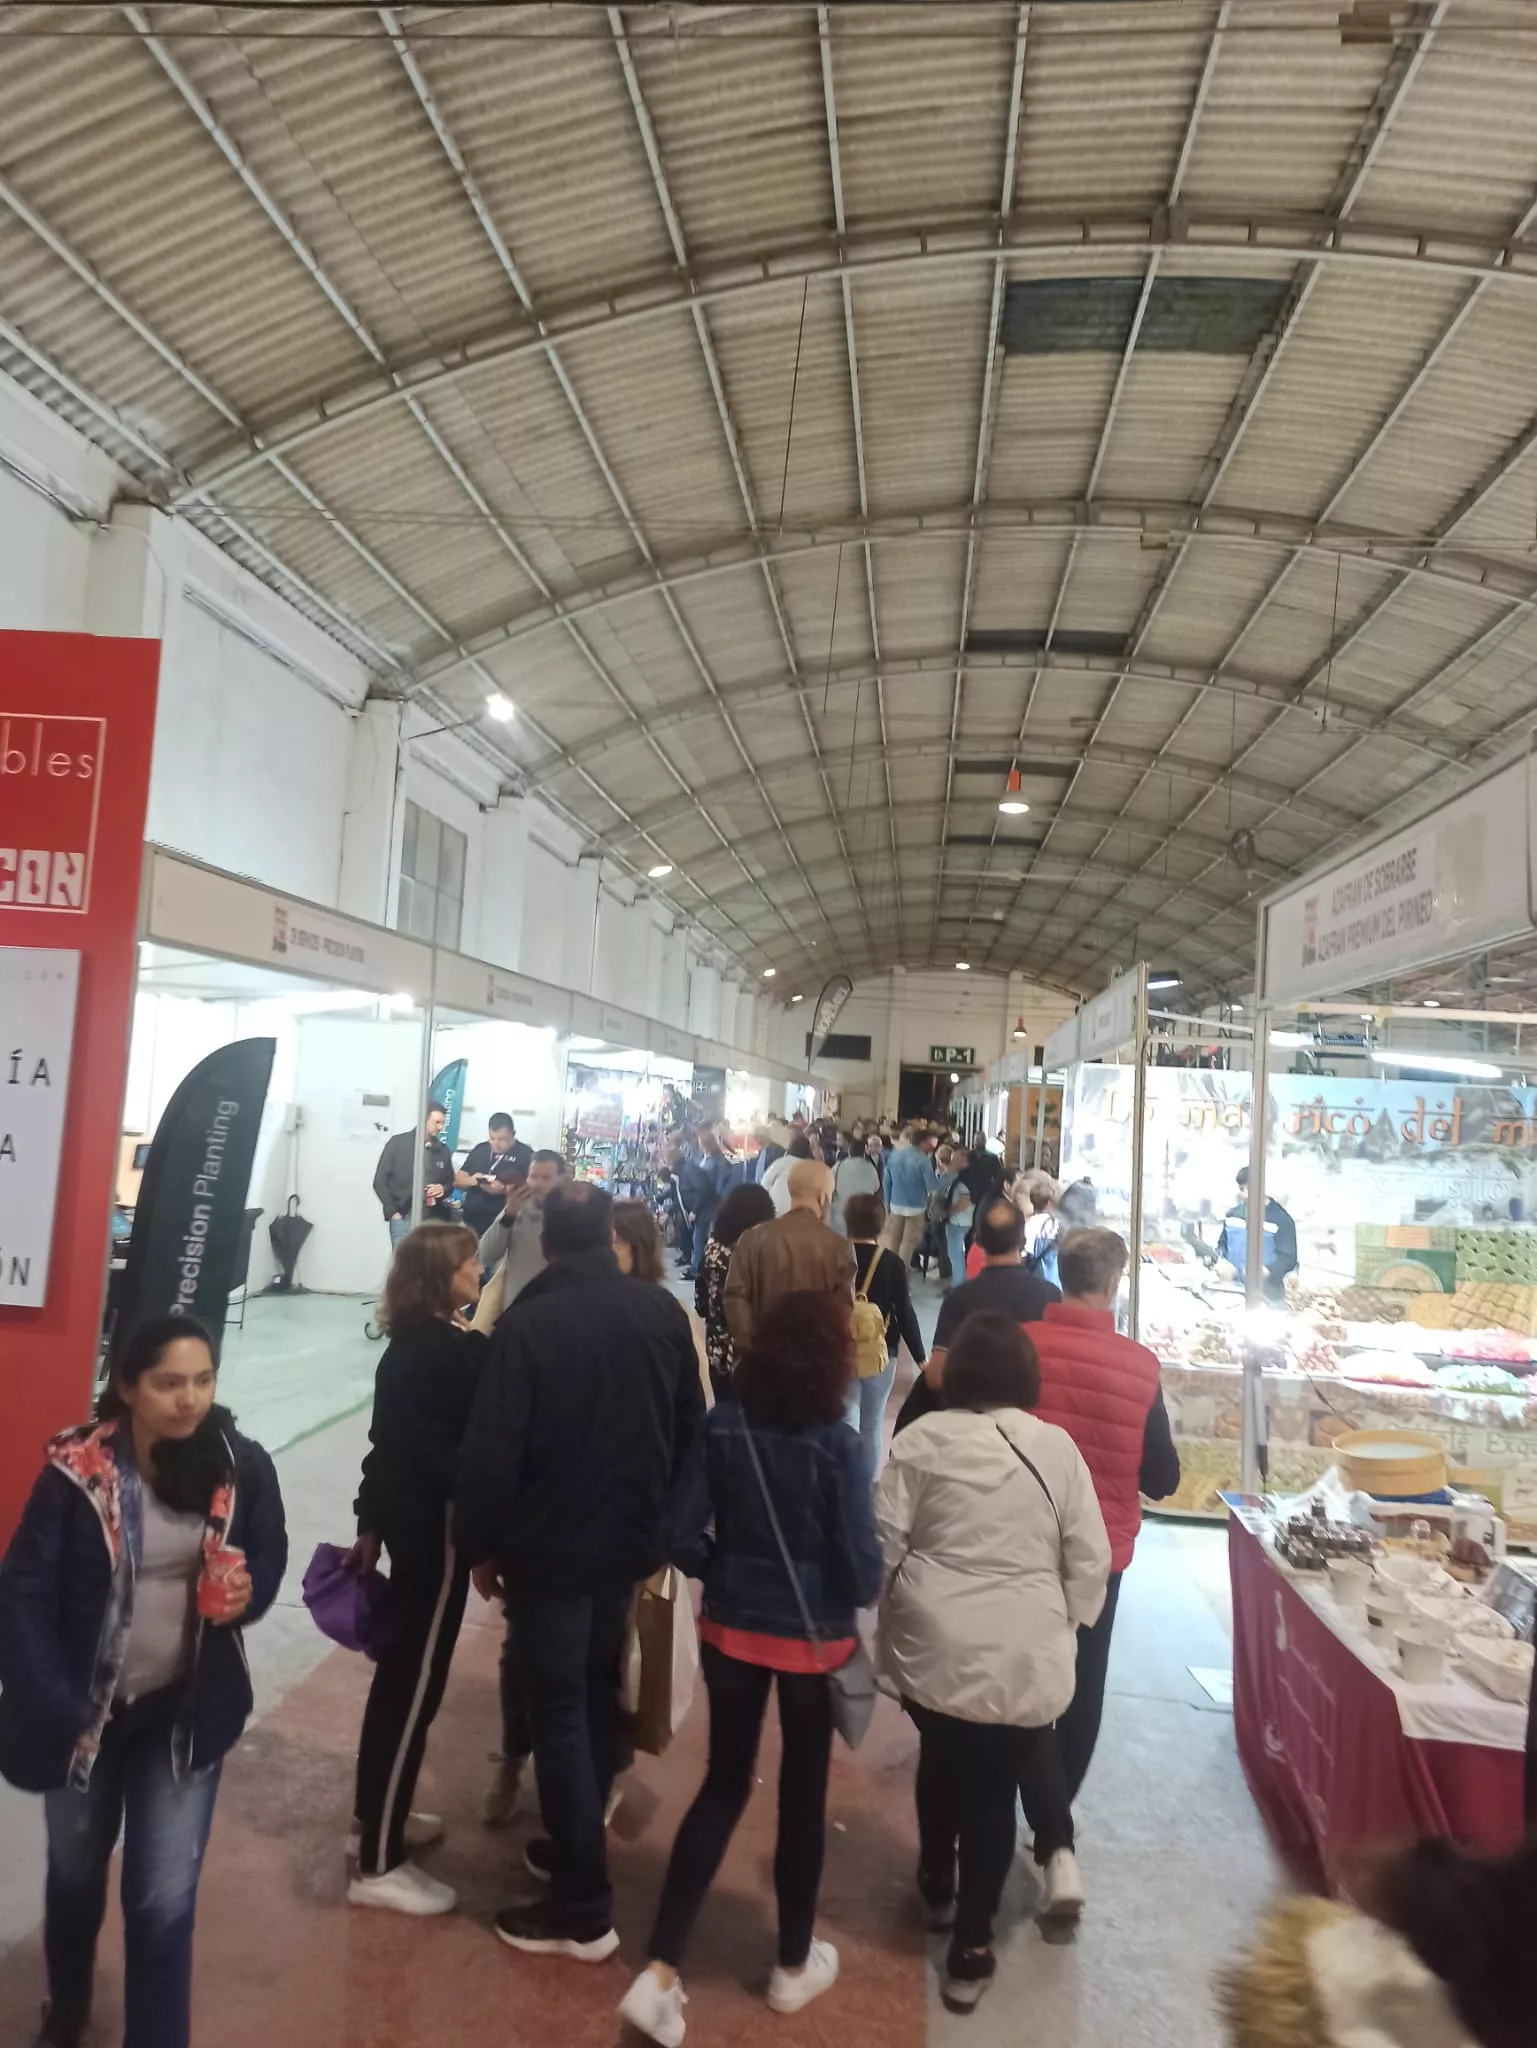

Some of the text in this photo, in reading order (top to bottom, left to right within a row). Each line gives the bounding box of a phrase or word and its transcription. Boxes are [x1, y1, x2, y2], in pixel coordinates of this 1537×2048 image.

[0, 719, 94, 779] bles
[8, 1048, 51, 1087] ÍA
[193, 1099, 240, 1197] Planting
[1288, 1094, 1372, 1137] rico
[1400, 1095, 1465, 1147] del
